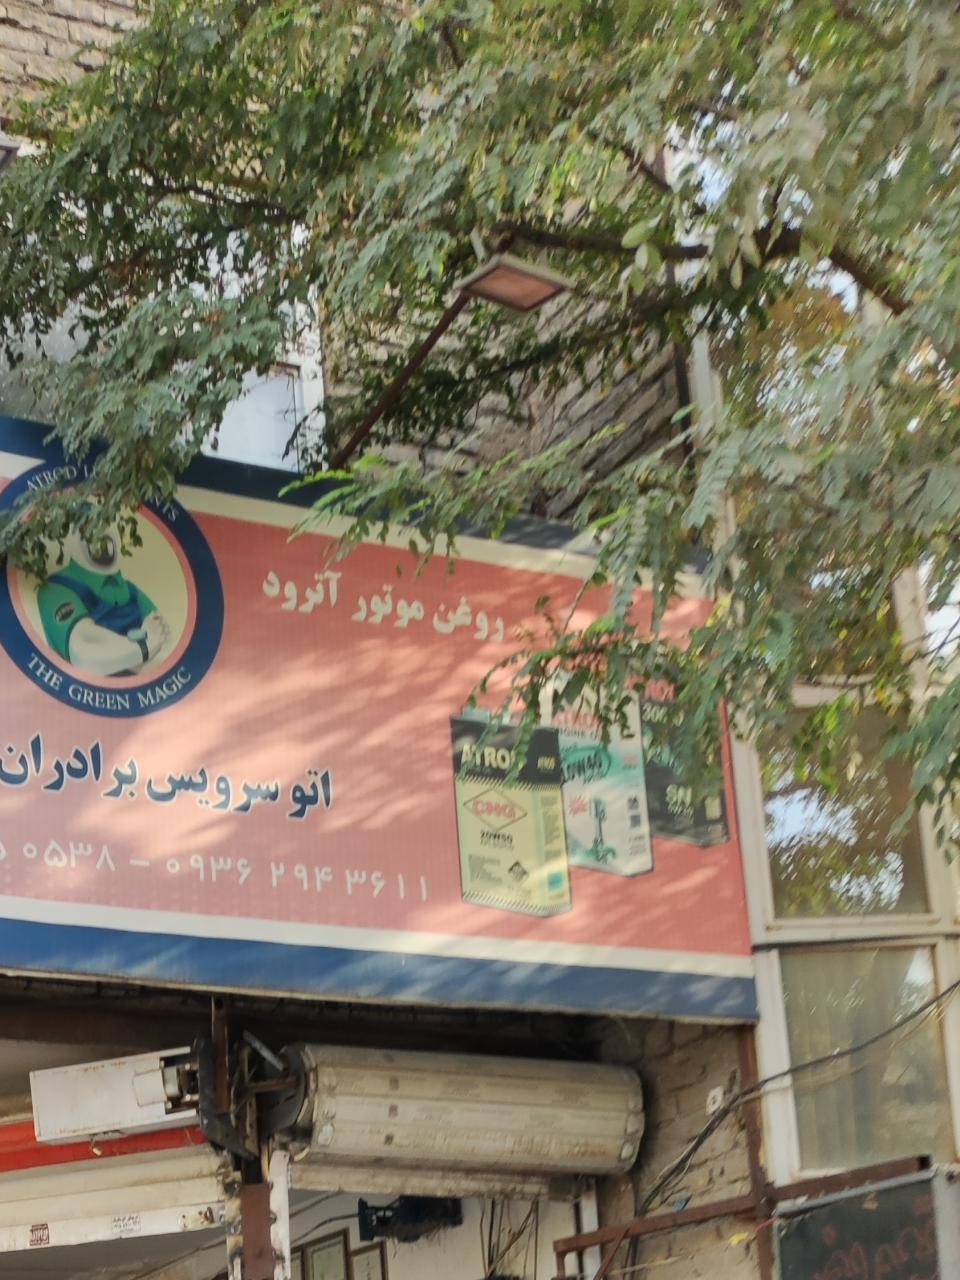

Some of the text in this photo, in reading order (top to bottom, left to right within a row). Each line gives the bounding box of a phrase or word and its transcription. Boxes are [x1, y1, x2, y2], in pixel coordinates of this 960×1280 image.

[262, 570, 505, 641] روغن موتور آترود
[27, 653, 193, 711] THE GREEN MAGIC
[146, 766, 279, 812] سرویس
[288, 768, 333, 820] اتو
[22, 840, 117, 872] ۰۵۳۸
[166, 854, 252, 887] ۰۹۳۶
[270, 862, 334, 894] ۲۹۴
[345, 871, 428, 901] ۳۶۱۱
